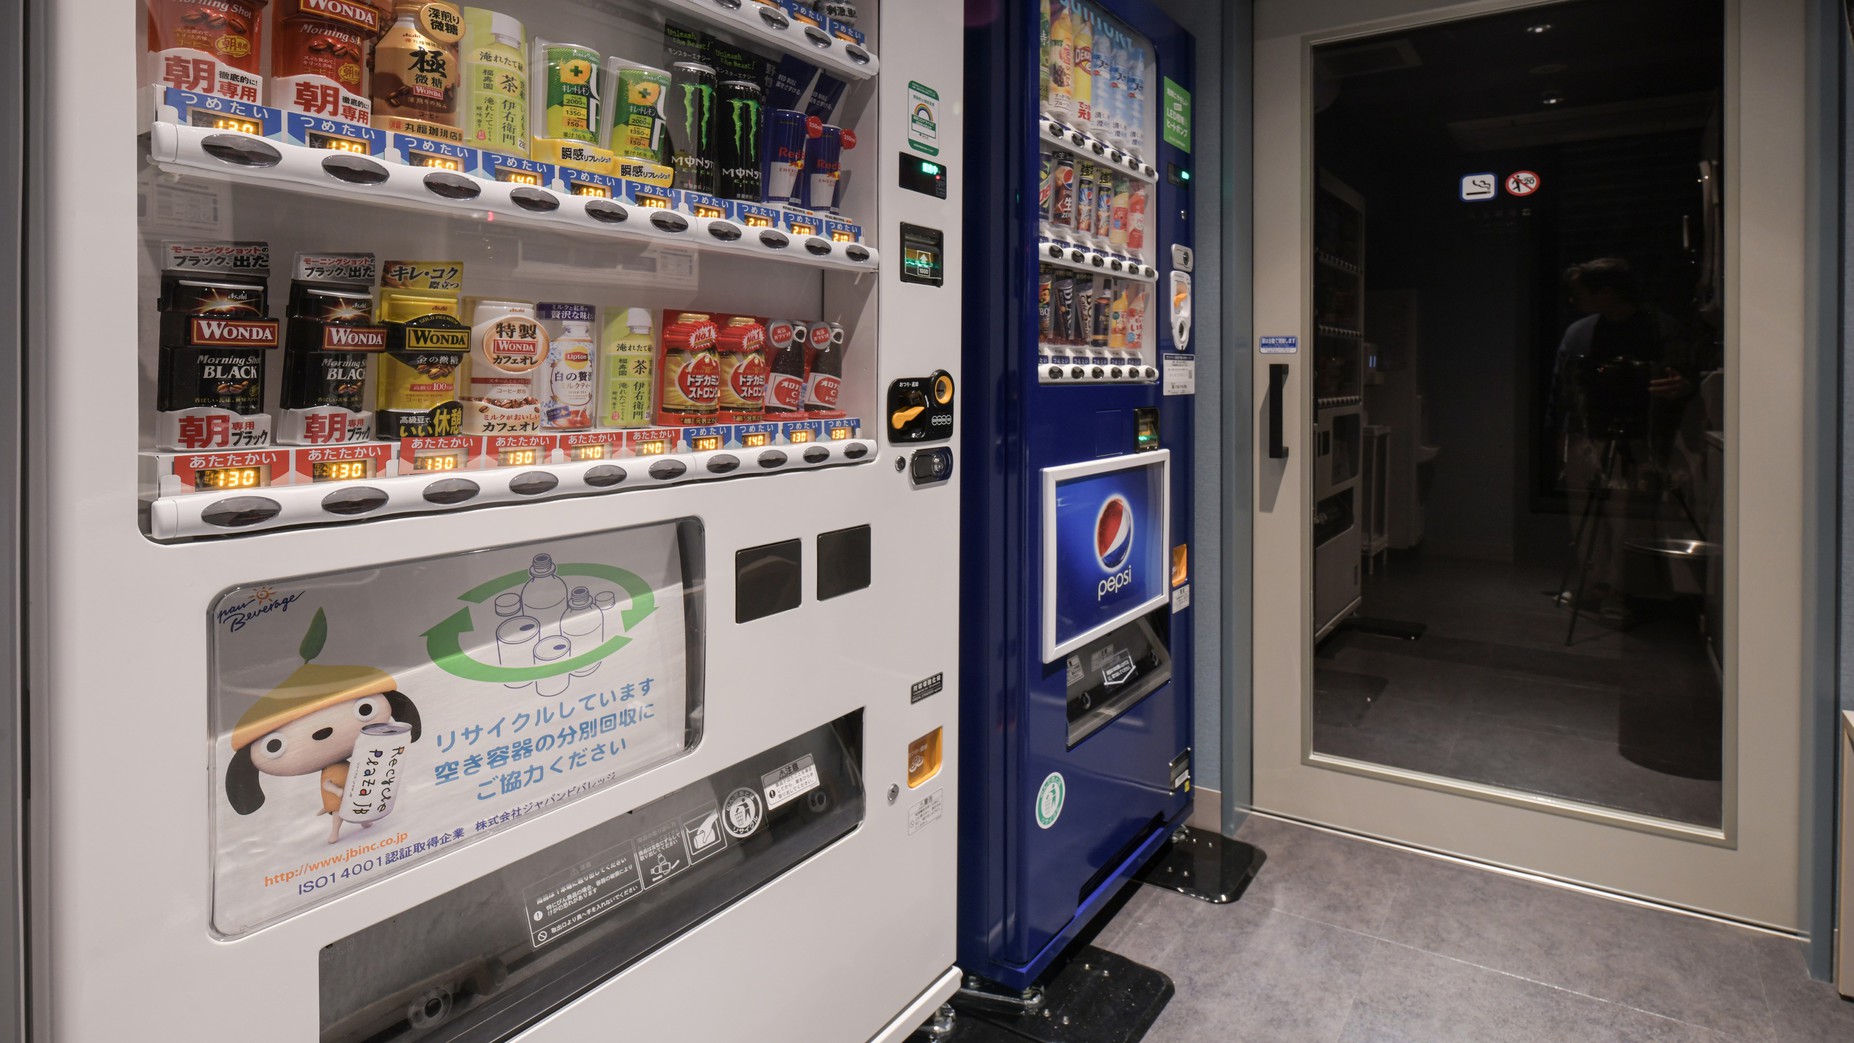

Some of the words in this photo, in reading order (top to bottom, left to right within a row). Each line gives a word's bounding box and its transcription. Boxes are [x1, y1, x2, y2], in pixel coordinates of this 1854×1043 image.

[231, 5, 252, 19] Shot
[308, 0, 374, 25] WONDA
[428, 7, 460, 25] 深煎り
[792, 3, 823, 22] つめたい
[300, 24, 349, 43] Morning
[430, 19, 459, 36] 微糖
[833, 21, 861, 39] つめたい
[408, 46, 447, 79] 極
[163, 56, 216, 94] 朝
[218, 70, 258, 87] 徹底的に!
[414, 73, 443, 89] 微糖
[217, 80, 257, 103] 専用
[415, 85, 442, 98] WONDA
[499, 74, 518, 93] 茶
[180, 92, 269, 119] つめたい
[294, 81, 340, 117] 朝
[341, 105, 369, 125] 専用
[501, 99, 517, 146] 伊右衛門
[300, 116, 375, 140] つめたい
[404, 122, 458, 141] 丸福珈琲店
[405, 137, 470, 158] つめたい
[491, 155, 547, 174] つめたい
[567, 169, 616, 186] つめたい
[632, 183, 676, 198] つめたい
[692, 194, 729, 208] つめたい
[699, 208, 719, 219] 210
[742, 204, 776, 218] つめたい
[748, 217, 767, 228] 210
[788, 213, 819, 226] つめたい
[829, 221, 858, 233] つめたい
[793, 225, 810, 236] 210
[833, 233, 849, 243] 210
[171, 244, 269, 256] モーニングショットの
[391, 265, 460, 282] キレ・コク
[428, 281, 460, 290] 際立つ
[227, 290, 248, 301] Asahi
[198, 320, 274, 341] WONDA
[329, 327, 384, 346] WONDA
[411, 328, 466, 346] WONDA
[495, 322, 538, 340] 特製
[694, 328, 713, 343] No.1
[746, 330, 761, 345] No.1
[498, 340, 535, 352] WONDA
[196, 354, 245, 366] Morning
[321, 357, 360, 369] Morning
[492, 355, 539, 366] カフェオレ
[632, 359, 648, 376] 茶
[202, 365, 258, 379] BLACK
[632, 381, 646, 420] 伊右衛門
[347, 418, 364, 428] 専用
[483, 413, 540, 421] ミルクがおいしい
[828, 419, 857, 428] つめたい
[178, 414, 230, 449] 朝
[231, 421, 255, 431] 専用
[303, 412, 348, 444] 朝
[347, 425, 371, 441] ブラック
[482, 421, 539, 432] カフェオレ
[689, 426, 727, 436] つめたい
[739, 424, 774, 433] つめたい
[787, 421, 818, 430] つめたい
[231, 429, 268, 446] ブラック
[411, 435, 474, 449] あたたかい
[495, 434, 550, 447] あたたかい
[568, 432, 617, 445] あたたかい
[632, 430, 675, 441] あたたかい
[747, 435, 764, 446] 140
[792, 432, 806, 443] 130
[831, 429, 845, 440] 130
[642, 442, 662, 454] 140
[699, 438, 716, 450] 140
[189, 452, 277, 469] あたたかい
[308, 447, 382, 461] あたたかい
[509, 451, 533, 465] 130
[580, 446, 602, 459] 140
[331, 463, 363, 479] 130
[426, 456, 454, 471] 130
[217, 470, 255, 487] 130
[1097, 564, 1132, 601] pepsi
[223, 590, 306, 632] Beverage
[436, 677, 655, 754] リサイクルしています
[434, 702, 655, 786] 空き容器の分別回収に
[359, 749, 384, 796] Plaza
[476, 737, 627, 801] ご協力ください
[377, 745, 405, 813] Recycle
[264, 831, 408, 887] http://www.jbinc.co.jp
[298, 826, 465, 896] ISO14001認証取得企業
